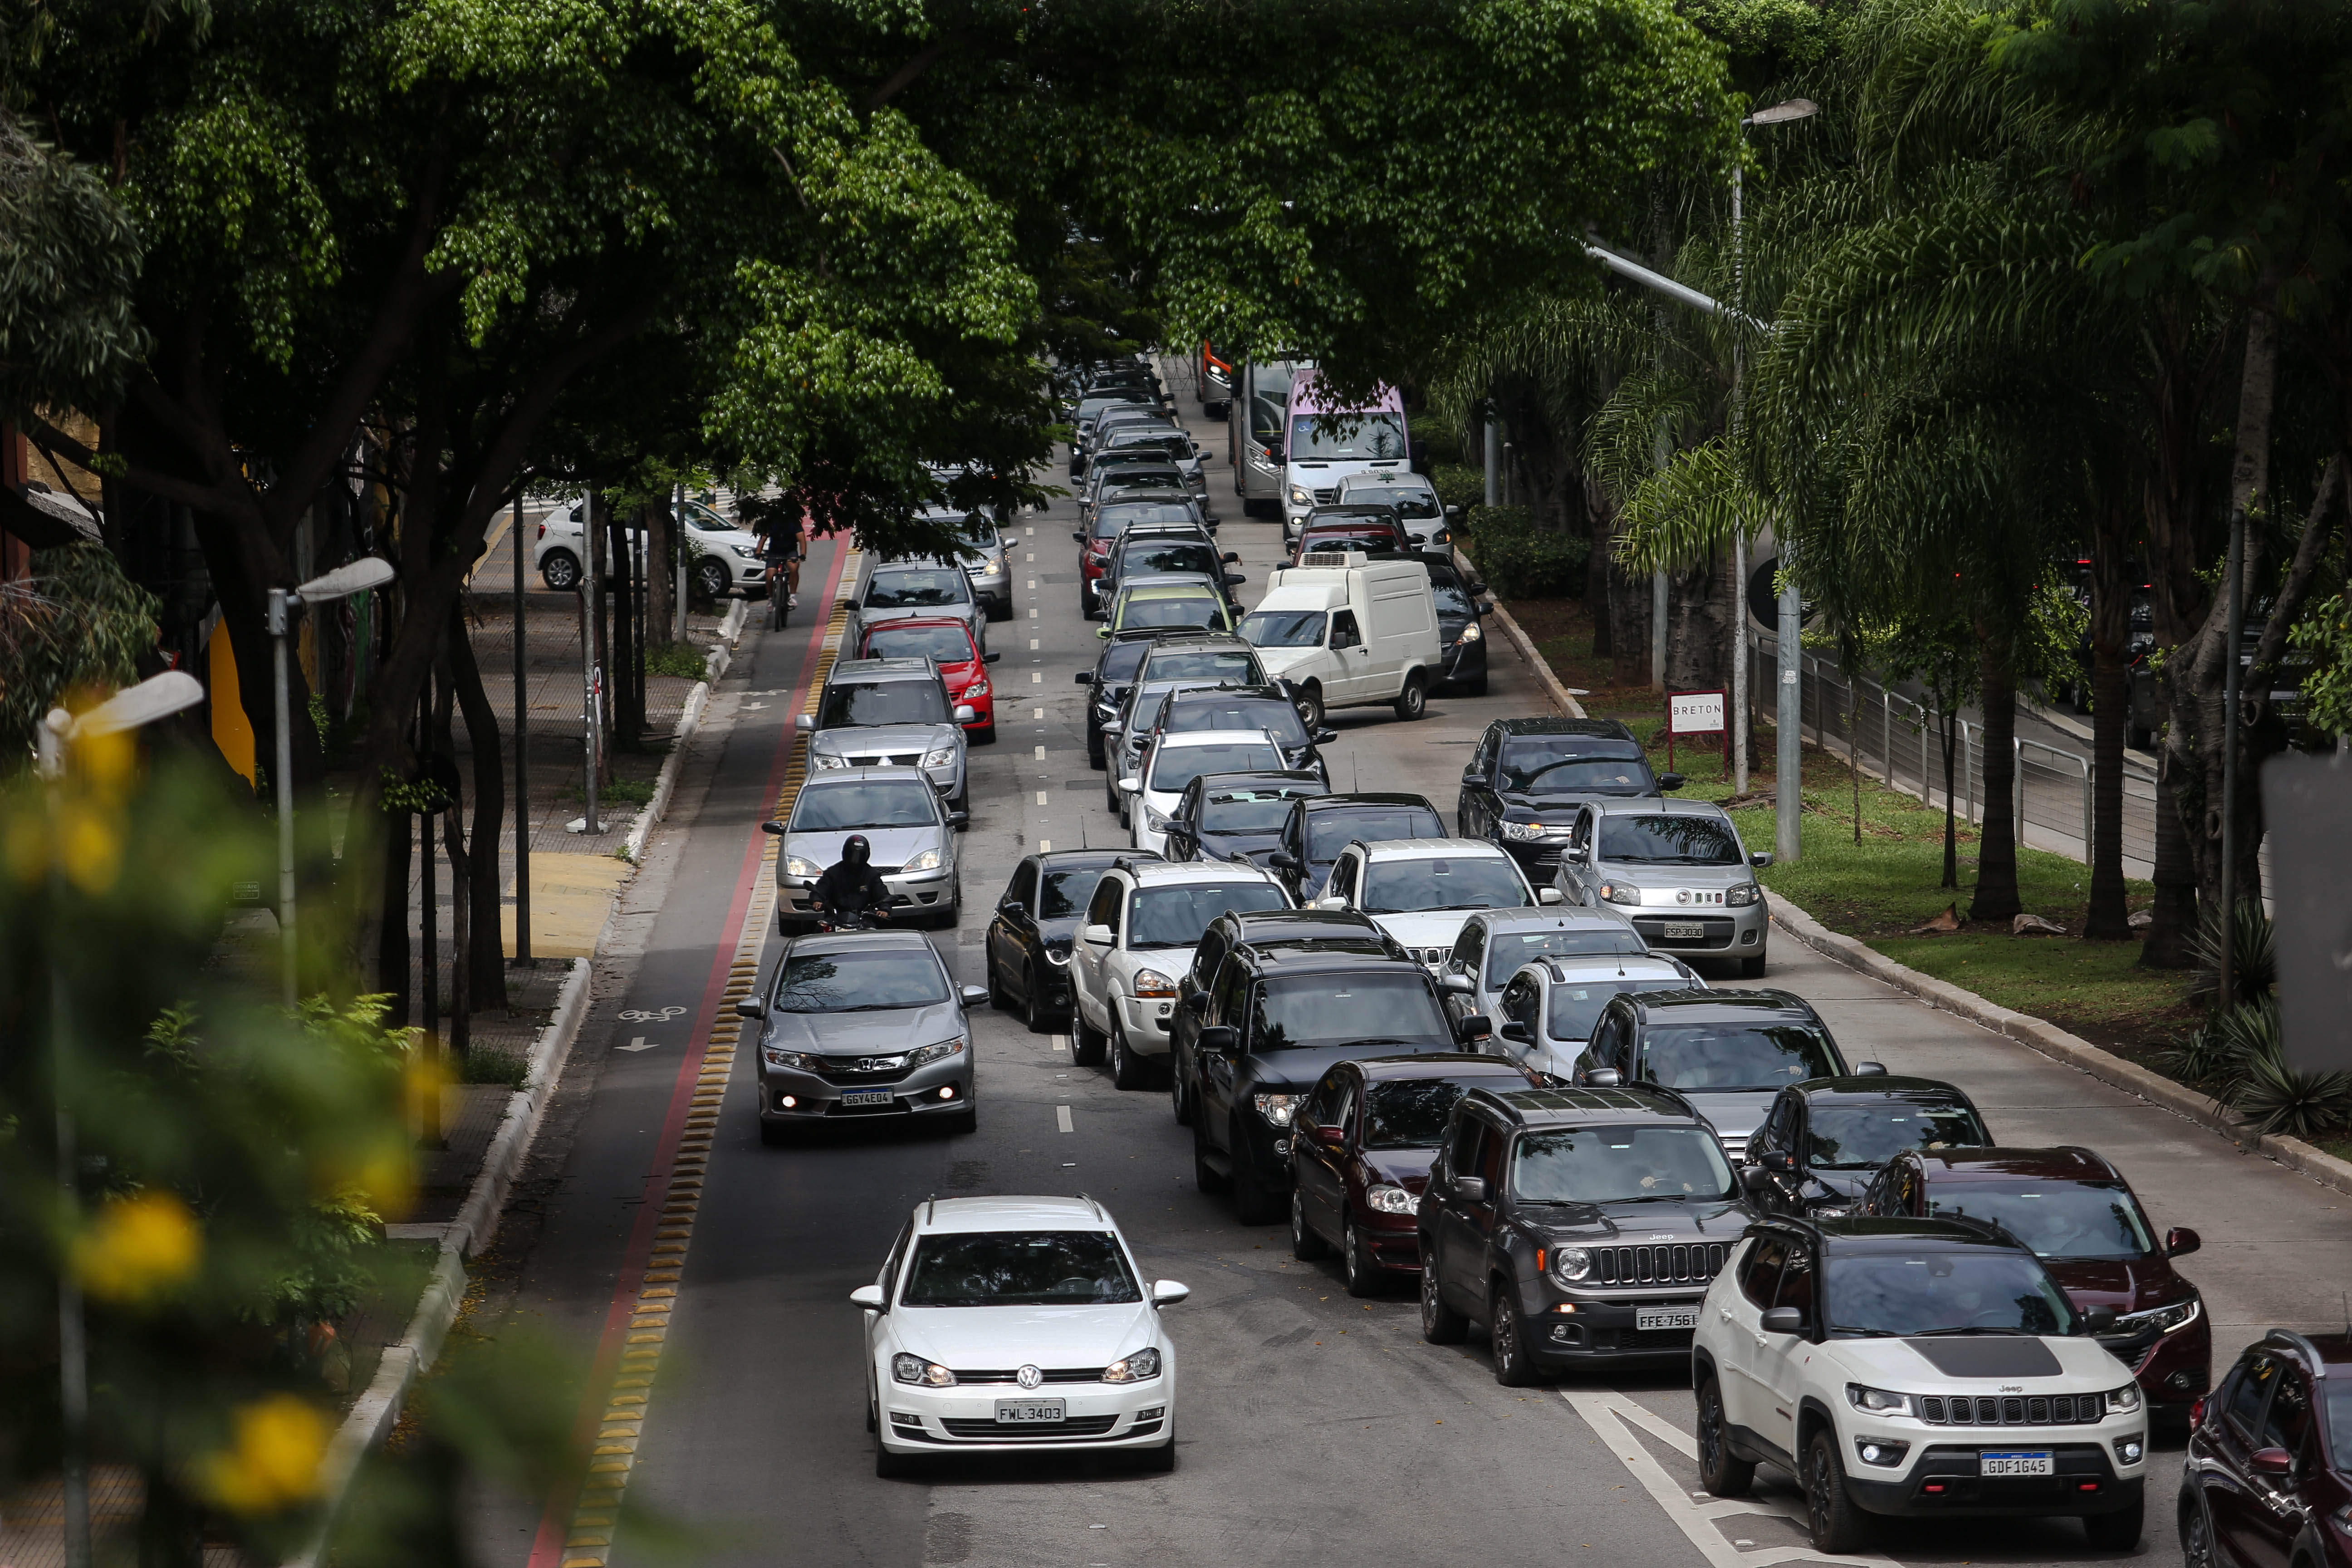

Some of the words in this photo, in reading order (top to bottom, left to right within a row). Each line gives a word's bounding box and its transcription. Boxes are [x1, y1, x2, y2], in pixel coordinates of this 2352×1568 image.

[1673, 705, 1720, 715] BRETON
[846, 1093, 888, 1104] GGY4E04
[1989, 1460, 2045, 1473] GDF1G45
